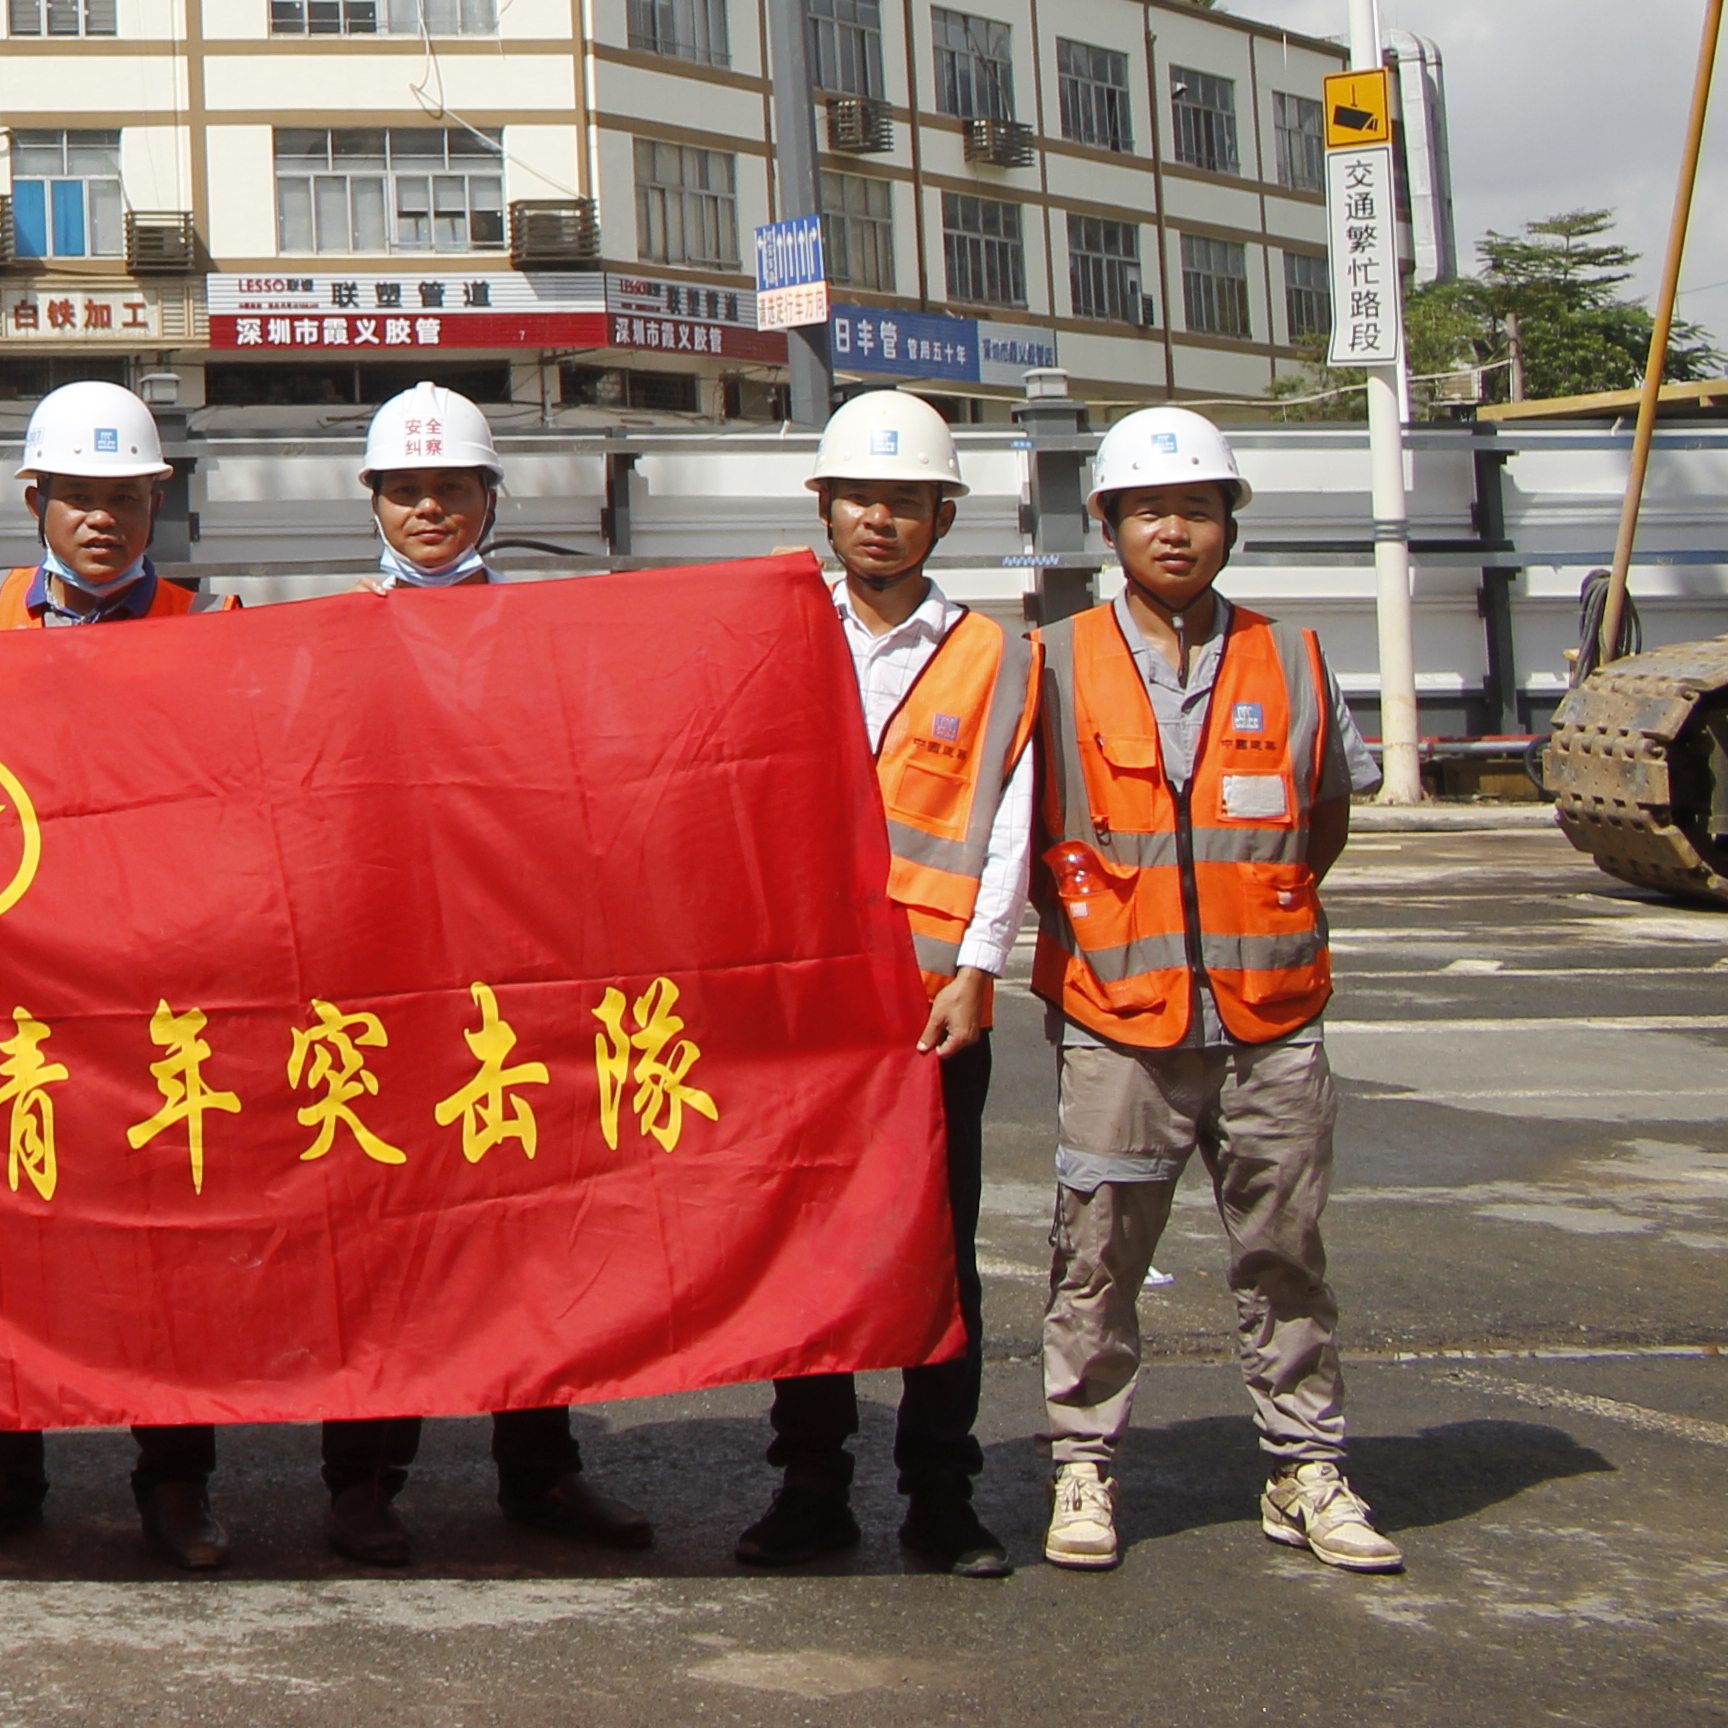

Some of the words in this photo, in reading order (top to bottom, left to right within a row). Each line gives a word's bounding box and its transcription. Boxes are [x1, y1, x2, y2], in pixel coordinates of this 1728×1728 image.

[1344, 159, 1382, 352] 交通繁忙路段
[331, 280, 491, 309] 联塑管道
[758, 287, 825, 327] 请选定行车方向
[14, 298, 149, 330] 白铁加工
[235, 317, 441, 346] 深圳市霞义胶管
[615, 316, 723, 354] 深圳市霞义胶管
[834, 317, 898, 360] 日丰管
[906, 337, 967, 366] 管用五十年
[405, 417, 443, 436] 安全
[405, 439, 443, 456] 纠察
